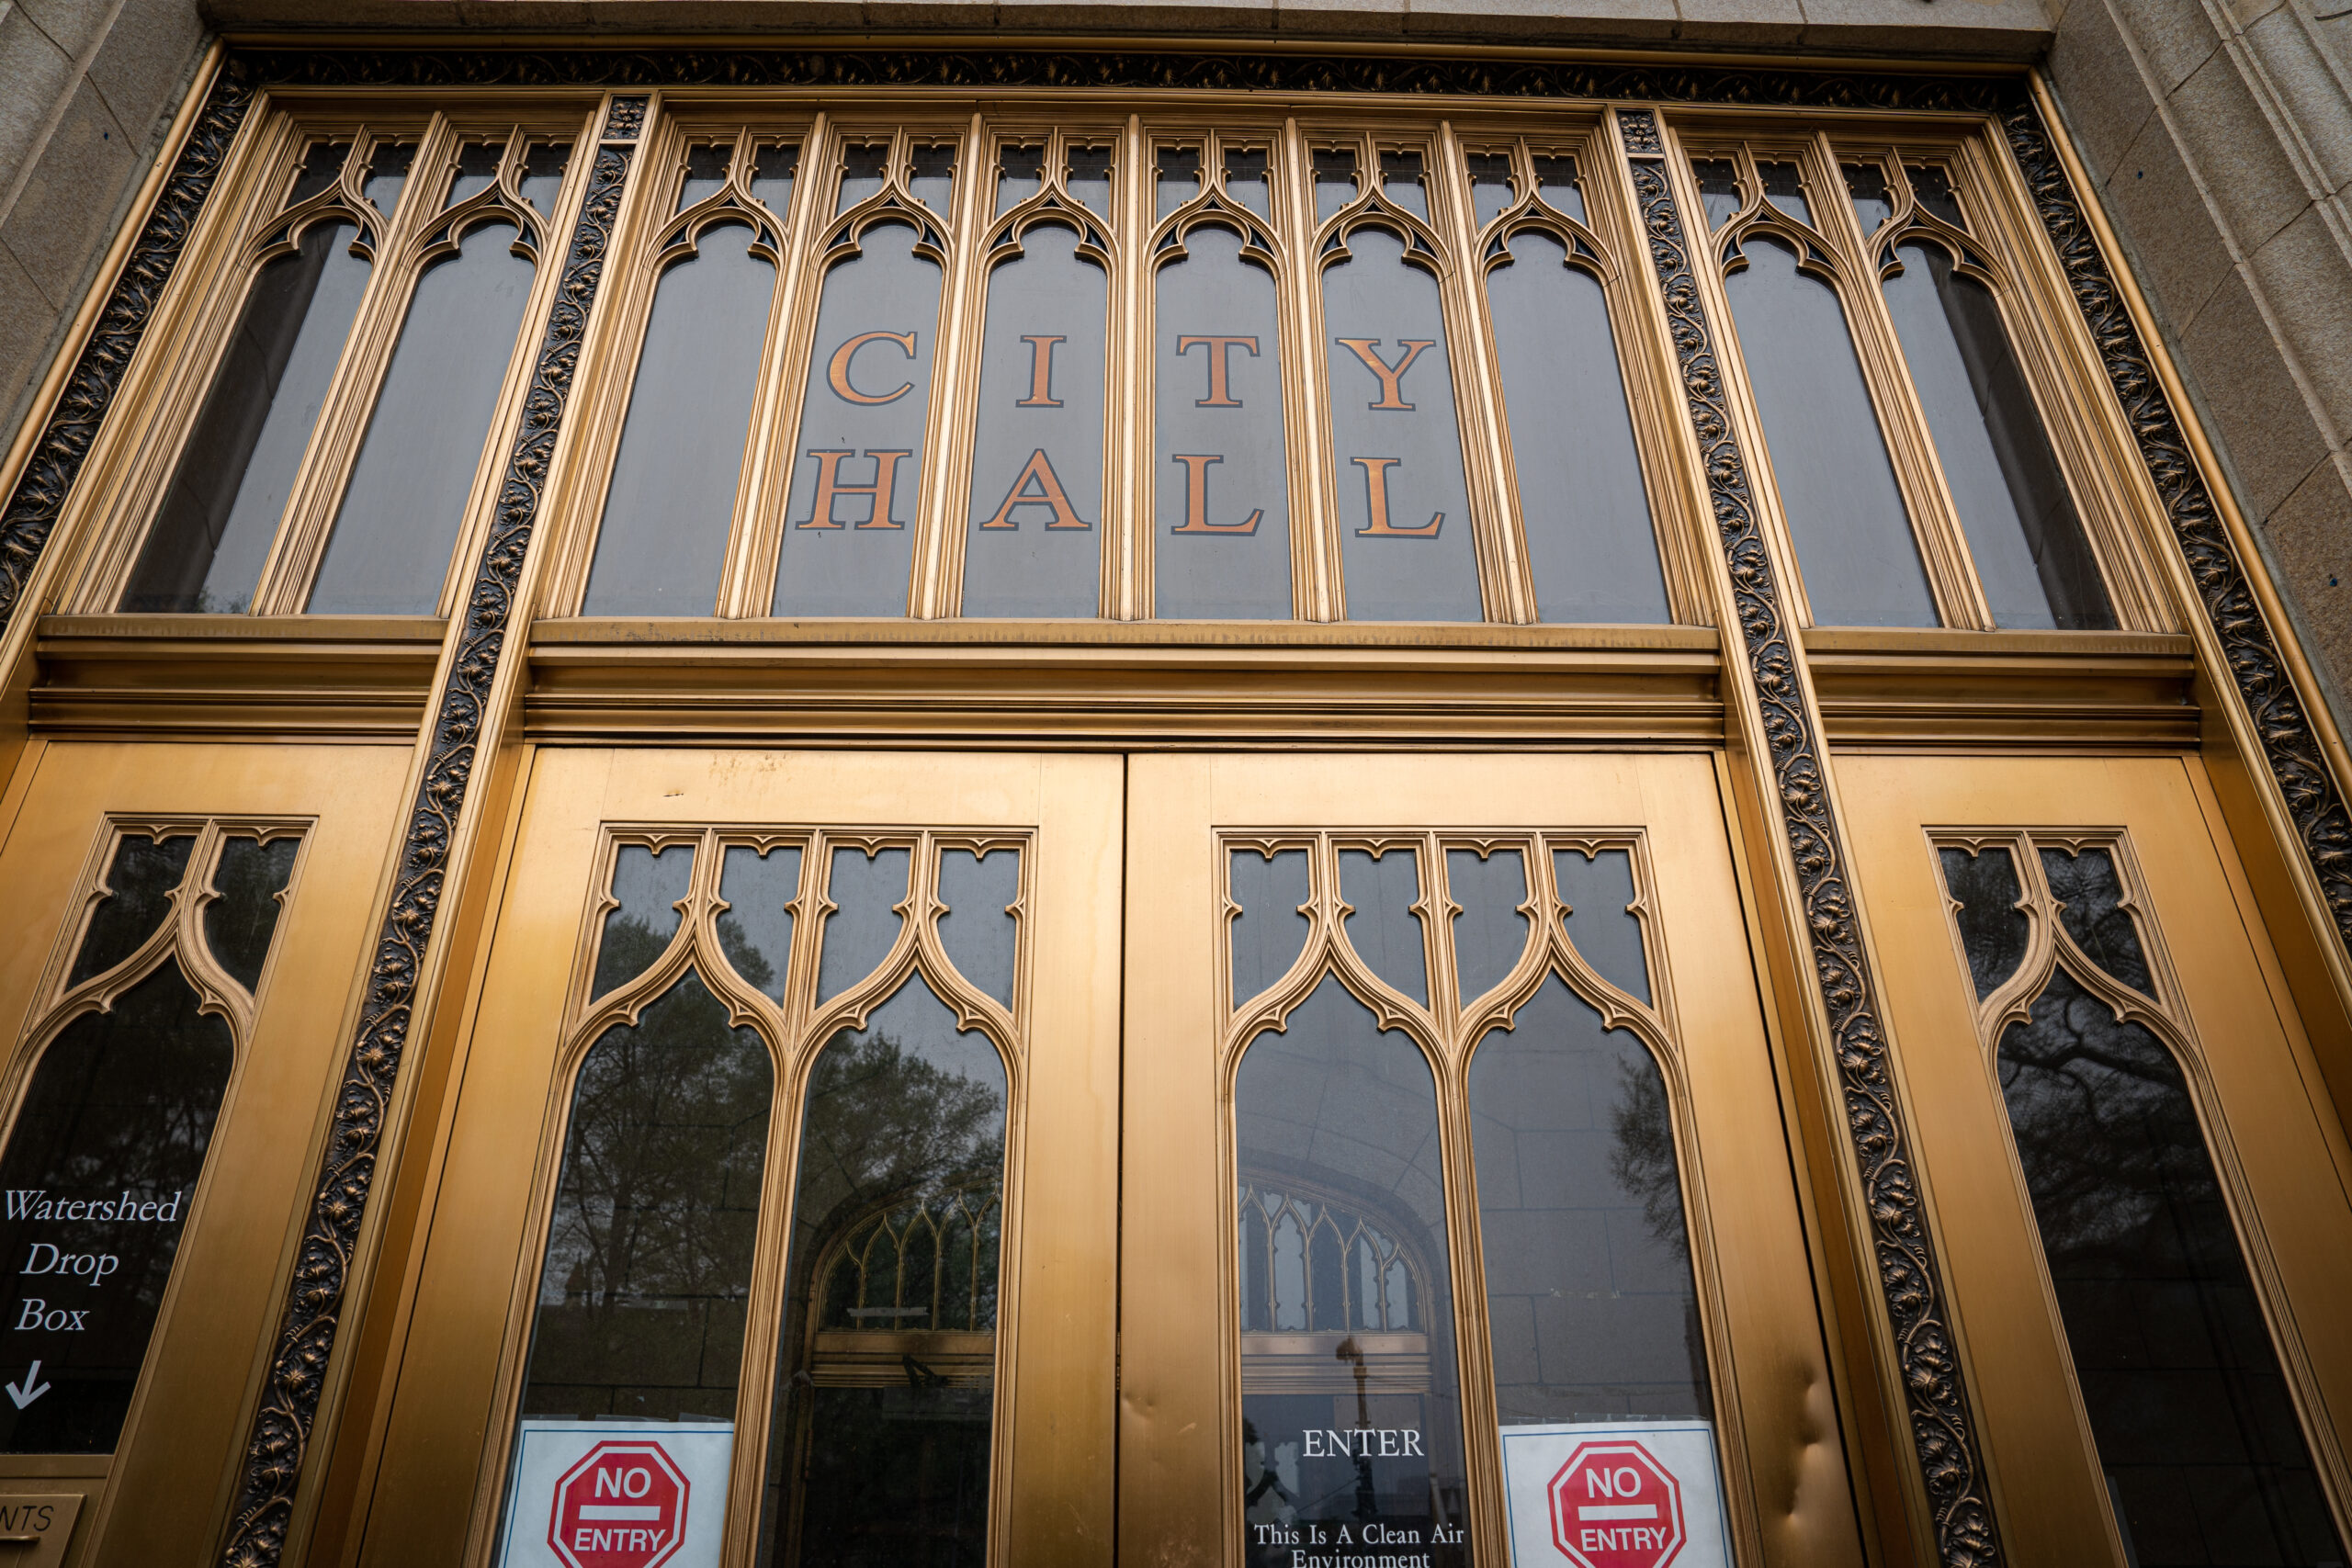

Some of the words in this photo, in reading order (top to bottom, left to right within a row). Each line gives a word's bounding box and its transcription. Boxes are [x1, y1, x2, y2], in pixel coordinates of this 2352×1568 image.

[826, 331, 1437, 412] CITY
[795, 448, 1446, 540] HALL
[5, 1190, 182, 1223] Watershed
[19, 1243, 119, 1286] Drop
[14, 1298, 90, 1331] Box
[1302, 1427, 1425, 1458] ENTER
[594, 1467, 651, 1498] NO
[1585, 1467, 1642, 1498] NO
[573, 1529, 667, 1552] ENTRY
[1254, 1523, 1300, 1545] This
[1309, 1524, 1327, 1545] Is
[1336, 1524, 1354, 1545] A
[1363, 1523, 1421, 1545] Clean
[1430, 1522, 1464, 1545] Air
[1580, 1527, 1668, 1552] ENTRY
[1291, 1548, 1430, 1568] Environment
